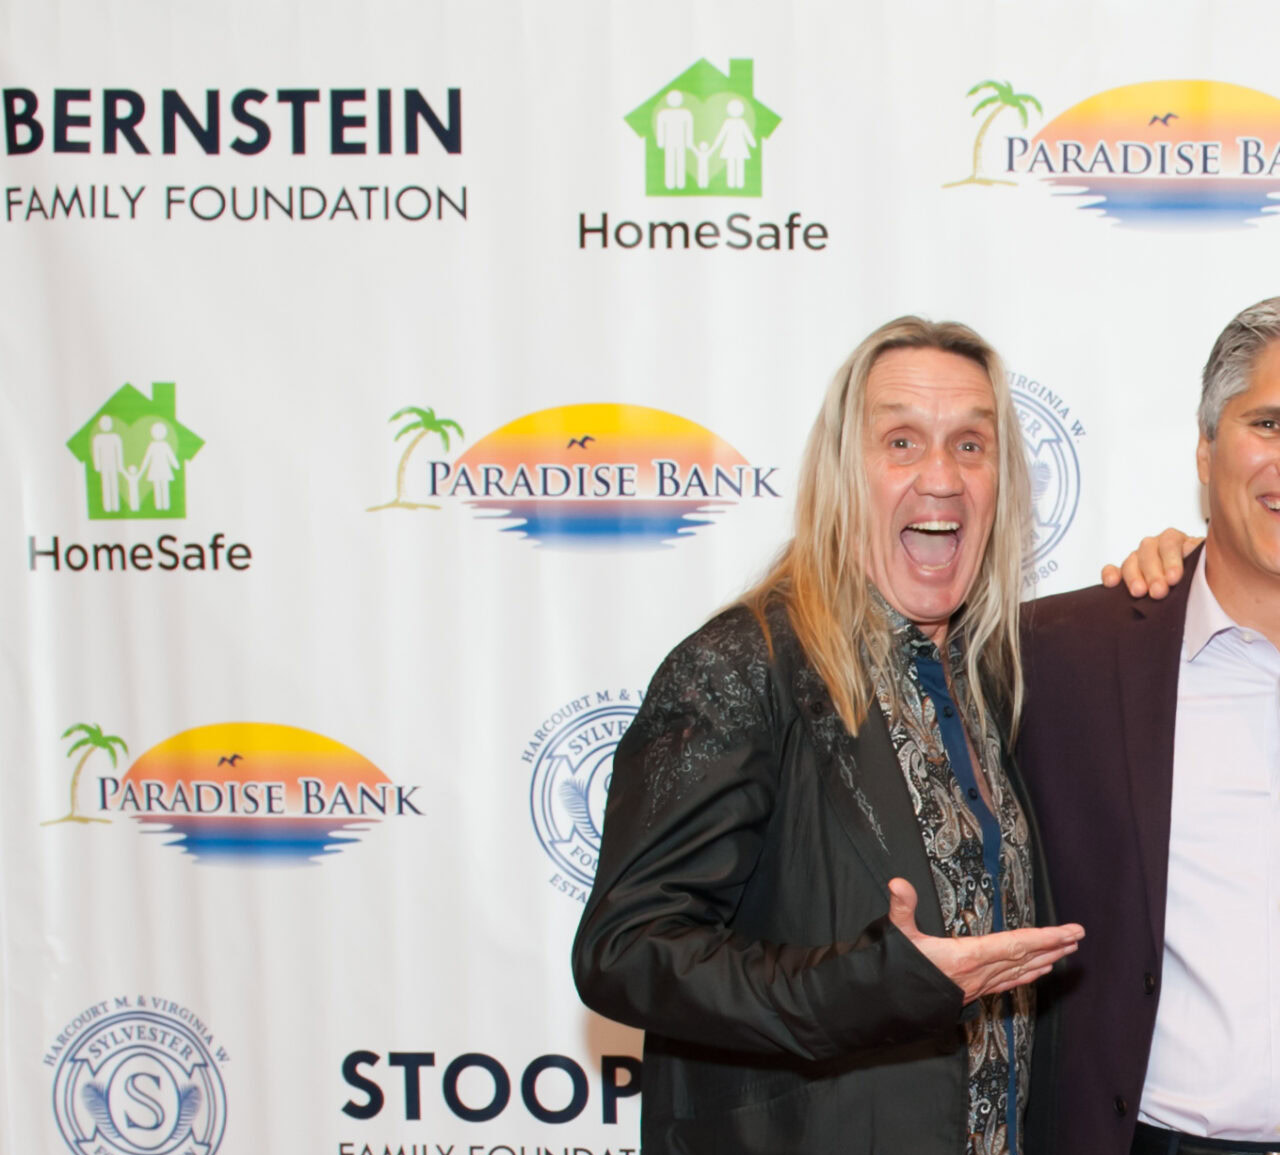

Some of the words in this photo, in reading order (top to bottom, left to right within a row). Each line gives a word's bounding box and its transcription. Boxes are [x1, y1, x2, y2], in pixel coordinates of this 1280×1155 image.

[1, 87, 462, 157] BERNSTEIN
[1006, 136, 1220, 174] PARADISE
[5, 185, 146, 222] FAMILY
[166, 185, 467, 222] FOUNDATION
[579, 212, 829, 251] HomeSafe
[1006, 371, 1070, 420] IRGINIA
[429, 462, 637, 497] PARADISE
[655, 460, 781, 498] BANK
[29, 533, 252, 572] HomeSafe
[521, 694, 592, 764] HARCOURT
[619, 689, 630, 700] &
[568, 720, 629, 757] SYLVE
[97, 776, 284, 813] PARADISE
[303, 778, 424, 816] BANK
[43, 1001, 110, 1067] HARCOURT
[137, 995, 147, 1007] &
[152, 997, 214, 1045] VIRGINIA
[88, 1025, 194, 1060] SYLVESTER
[341, 1050, 642, 1124] STOOP
